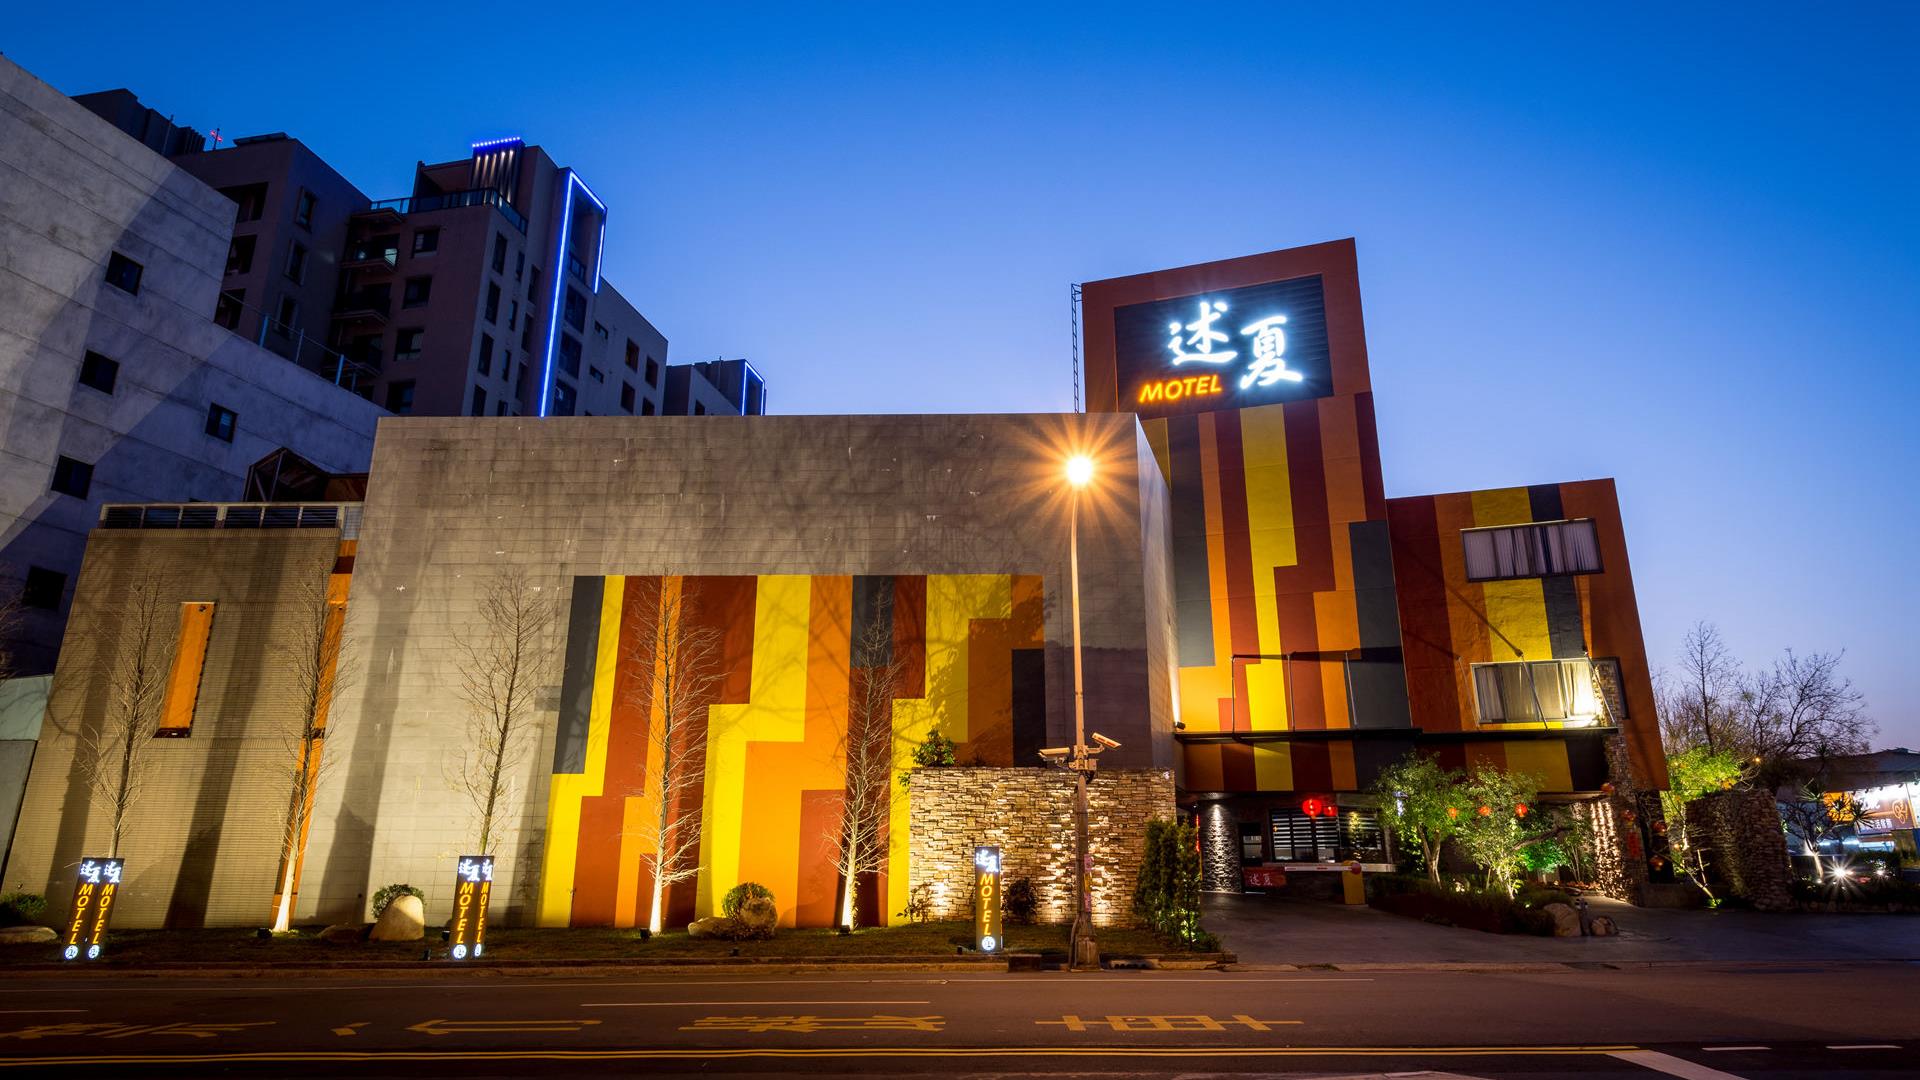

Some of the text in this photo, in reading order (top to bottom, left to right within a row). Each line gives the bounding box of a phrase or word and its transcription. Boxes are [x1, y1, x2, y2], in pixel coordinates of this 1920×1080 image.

[1168, 301, 1303, 389] 述夏
[1139, 374, 1222, 402] MOTEL
[70, 884, 93, 944] MOTEL
[92, 884, 114, 944] MOTEL
[457, 882, 474, 943] MOTEL
[477, 882, 489, 943] MOTEL
[980, 874, 993, 935] MOTEL
